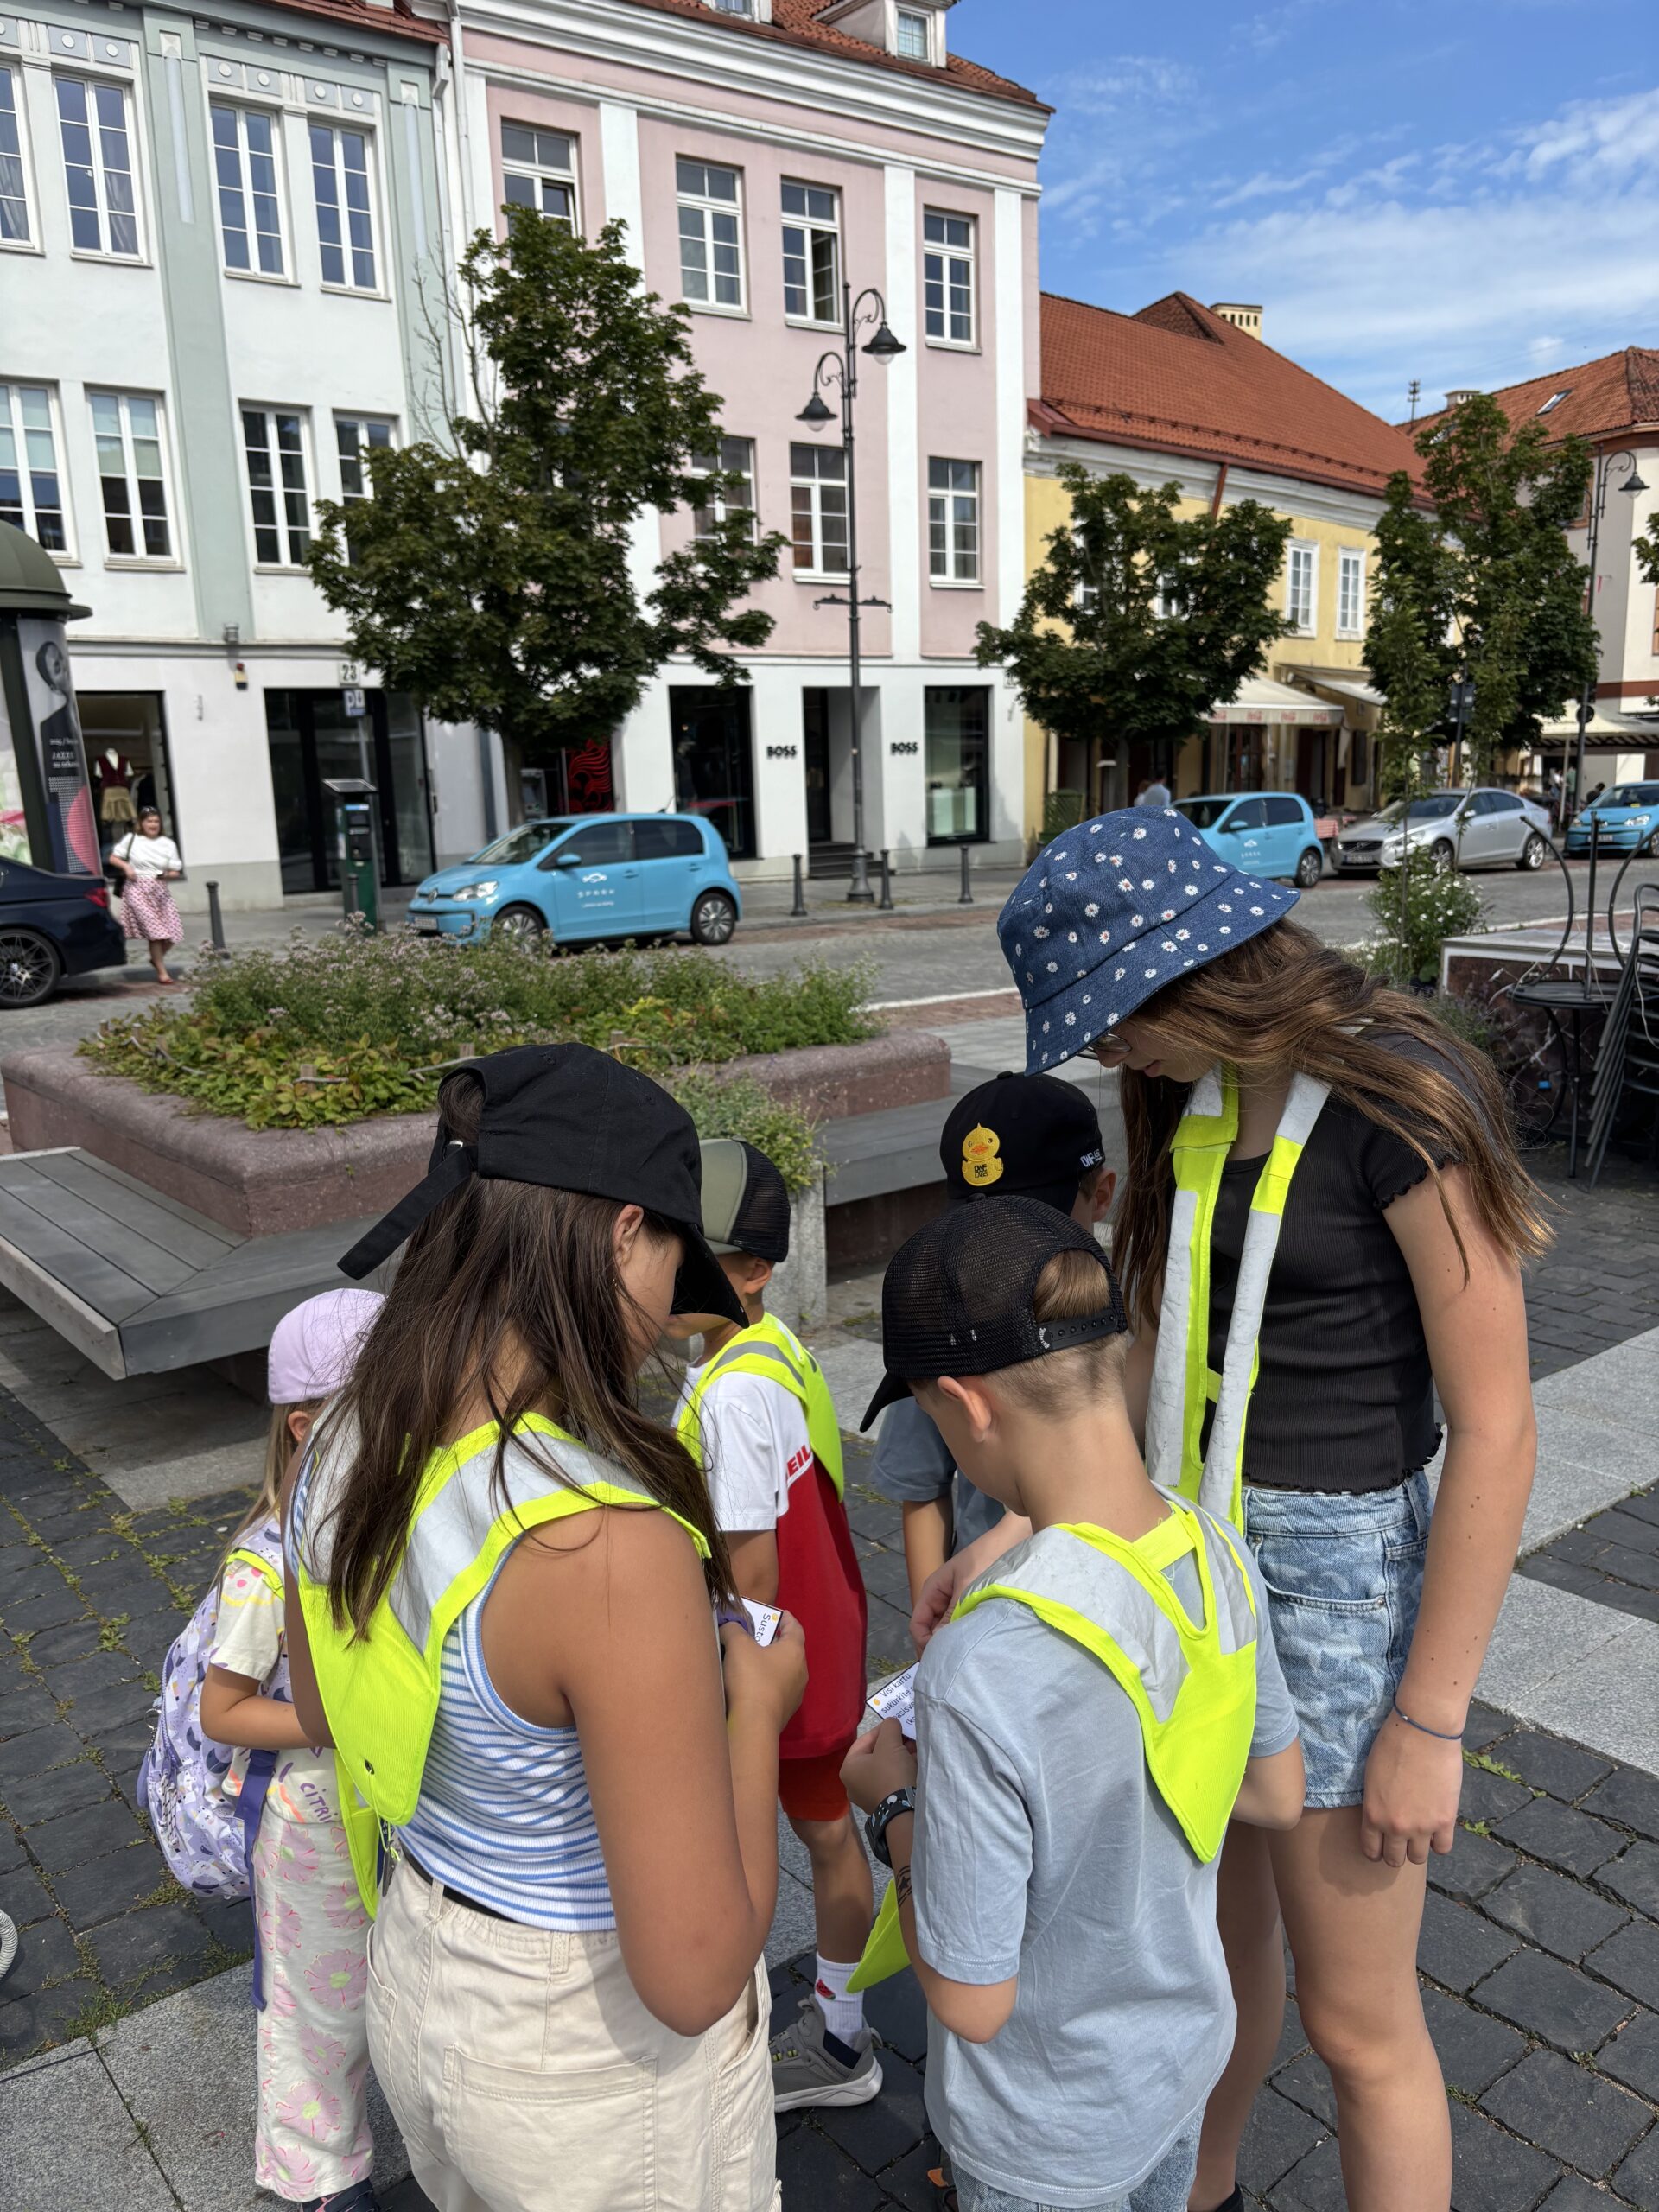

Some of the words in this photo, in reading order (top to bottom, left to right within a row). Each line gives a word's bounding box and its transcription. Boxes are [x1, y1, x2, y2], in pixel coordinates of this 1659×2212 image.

[342, 664, 357, 681] 23
[766, 745, 797, 759] BOSS
[891, 742, 918, 755] BOSS
[880, 1687, 894, 1697] Visi
[892, 1673, 912, 1688] kartu
[881, 1688, 912, 1713] sukurkite
[893, 1701, 915, 1719] asisve
